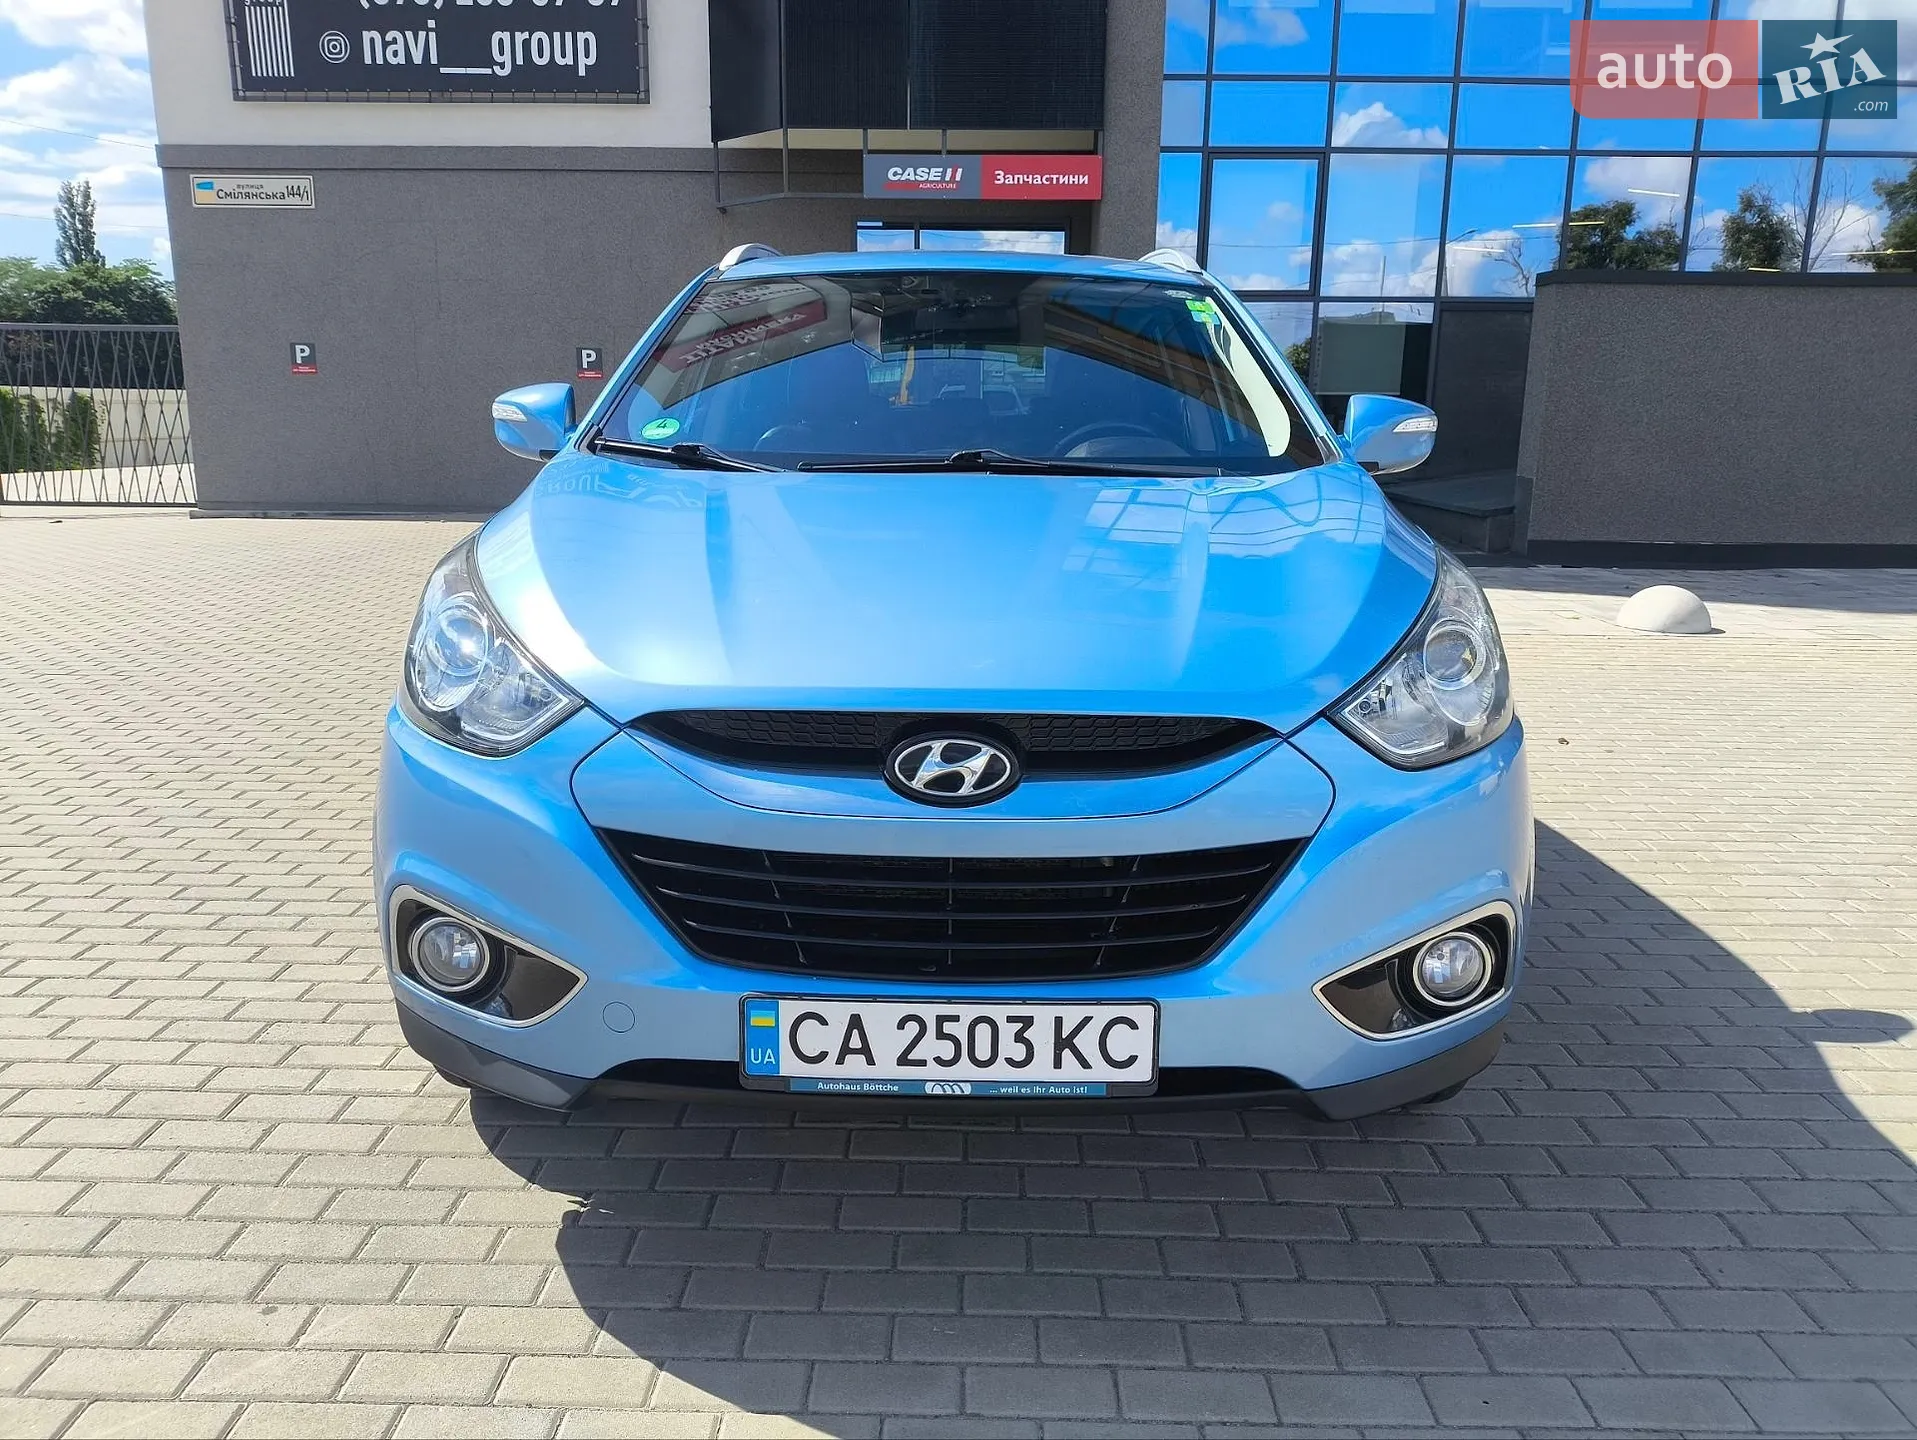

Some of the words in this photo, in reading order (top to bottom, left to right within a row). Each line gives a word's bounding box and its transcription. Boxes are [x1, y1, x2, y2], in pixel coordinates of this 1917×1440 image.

[887, 167, 943, 181] CASE
[994, 170, 1089, 185] Запчастини
[216, 188, 286, 201] Смілянська
[286, 185, 310, 201] 144/1
[295, 345, 310, 364] P
[581, 349, 597, 369] P
[788, 1011, 877, 1067] CA
[896, 1013, 1035, 1069] 2503
[1053, 1016, 1140, 1070] KC
[750, 1048, 776, 1065] UA
[817, 1082, 861, 1091] Autohaus
[863, 1082, 899, 1092] Böttche
[1048, 1085, 1071, 1094] Auto
